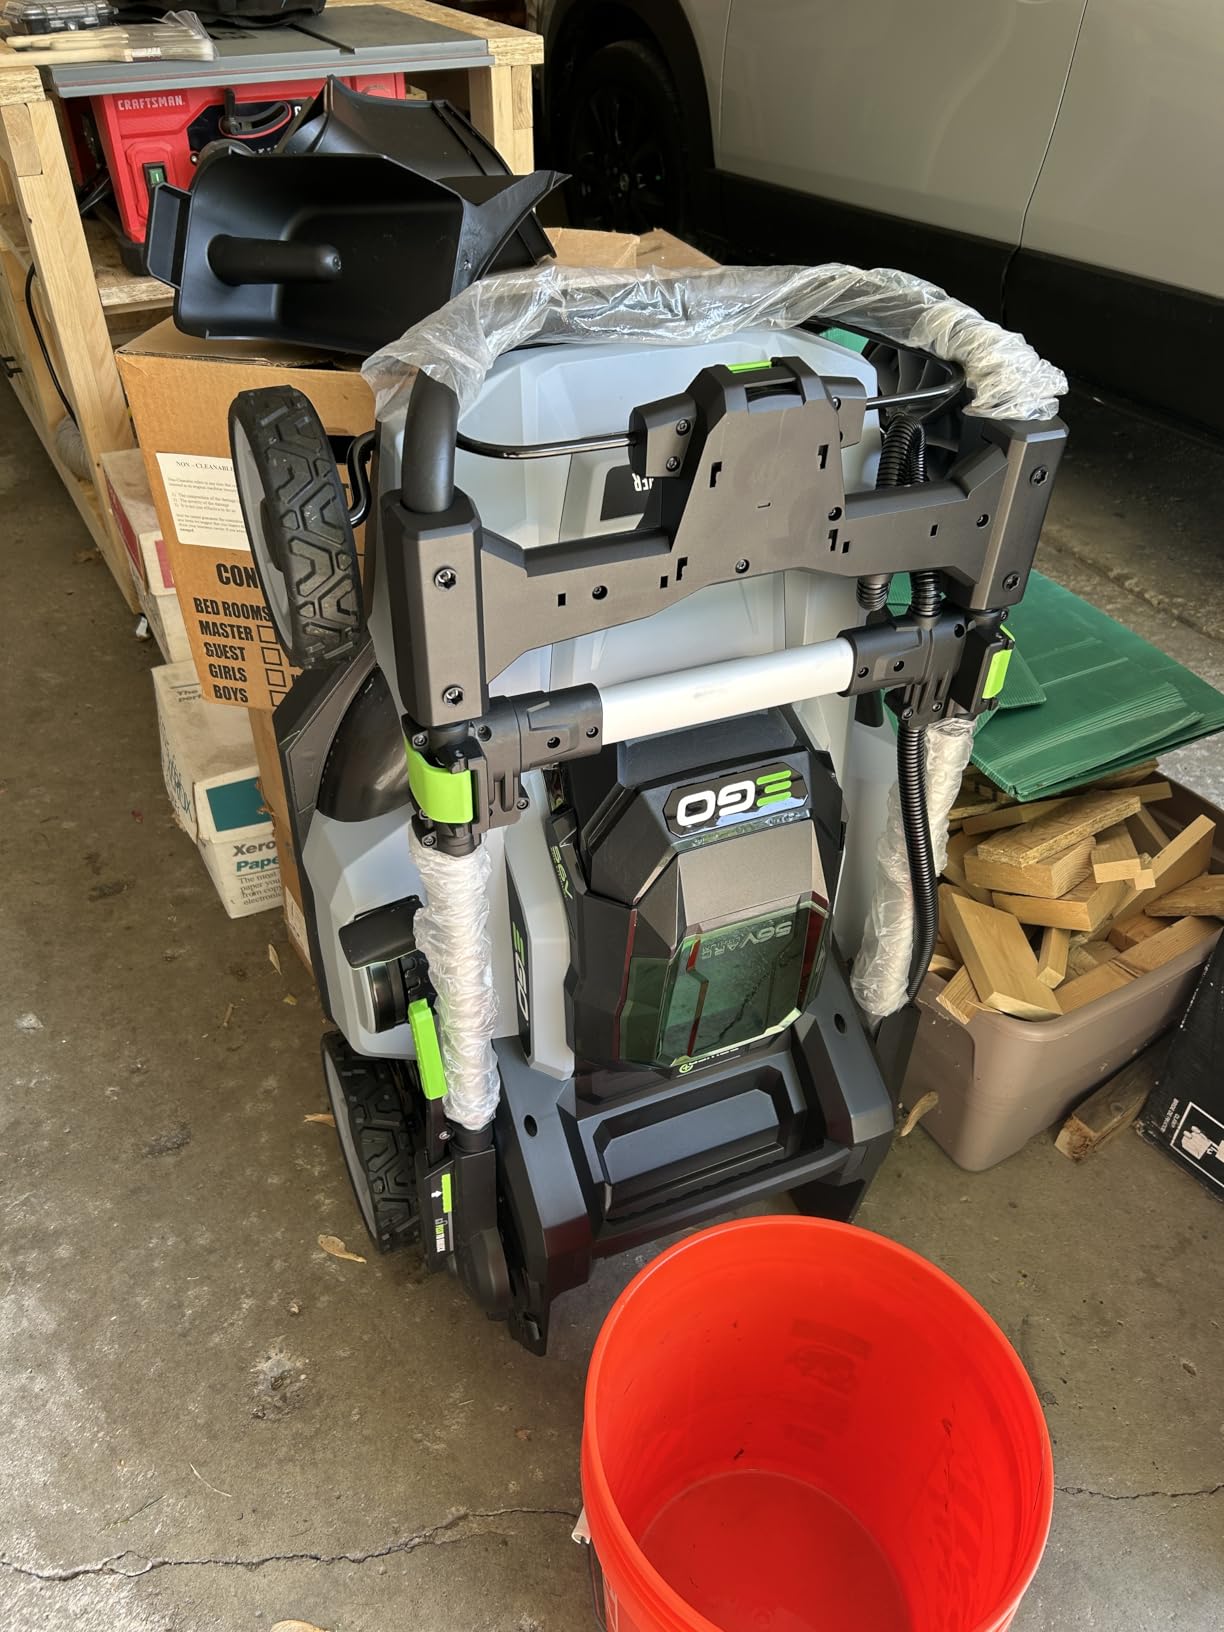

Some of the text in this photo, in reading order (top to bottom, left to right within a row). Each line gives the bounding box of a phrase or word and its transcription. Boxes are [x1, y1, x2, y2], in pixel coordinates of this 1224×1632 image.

[117, 95, 183, 111] CRAFTSMAN
[193, 597, 270, 622] BED ROOMS
[199, 620, 254, 642] MASTER
[204, 642, 246, 662] GUEST
[208, 663, 248, 683] GIRLS
[213, 684, 249, 703] BOYS
[676, 769, 792, 827] EGO
[512, 920, 530, 1022] EGO
